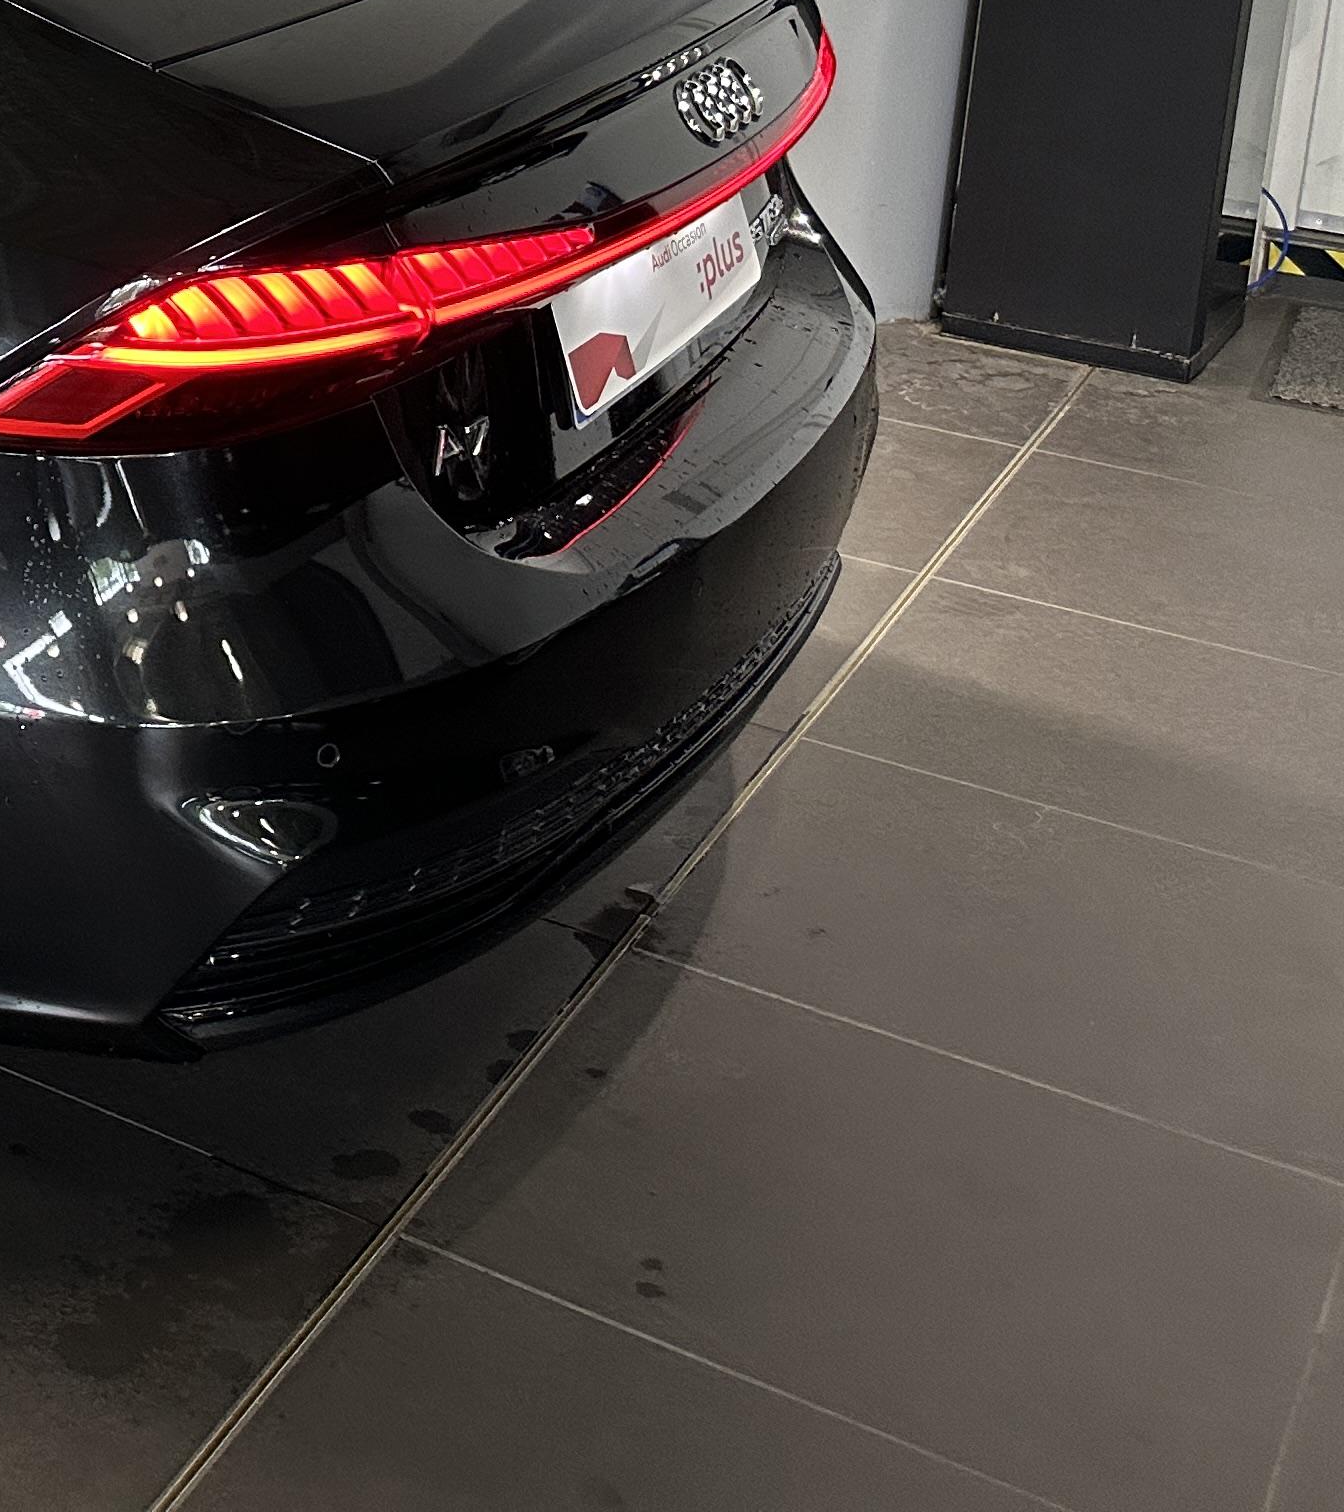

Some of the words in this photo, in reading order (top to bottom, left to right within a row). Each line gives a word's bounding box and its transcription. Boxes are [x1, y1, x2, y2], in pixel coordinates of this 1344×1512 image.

[650, 245, 673, 272] Audi
[671, 222, 707, 258] Occasion
[433, 415, 490, 477] A7
